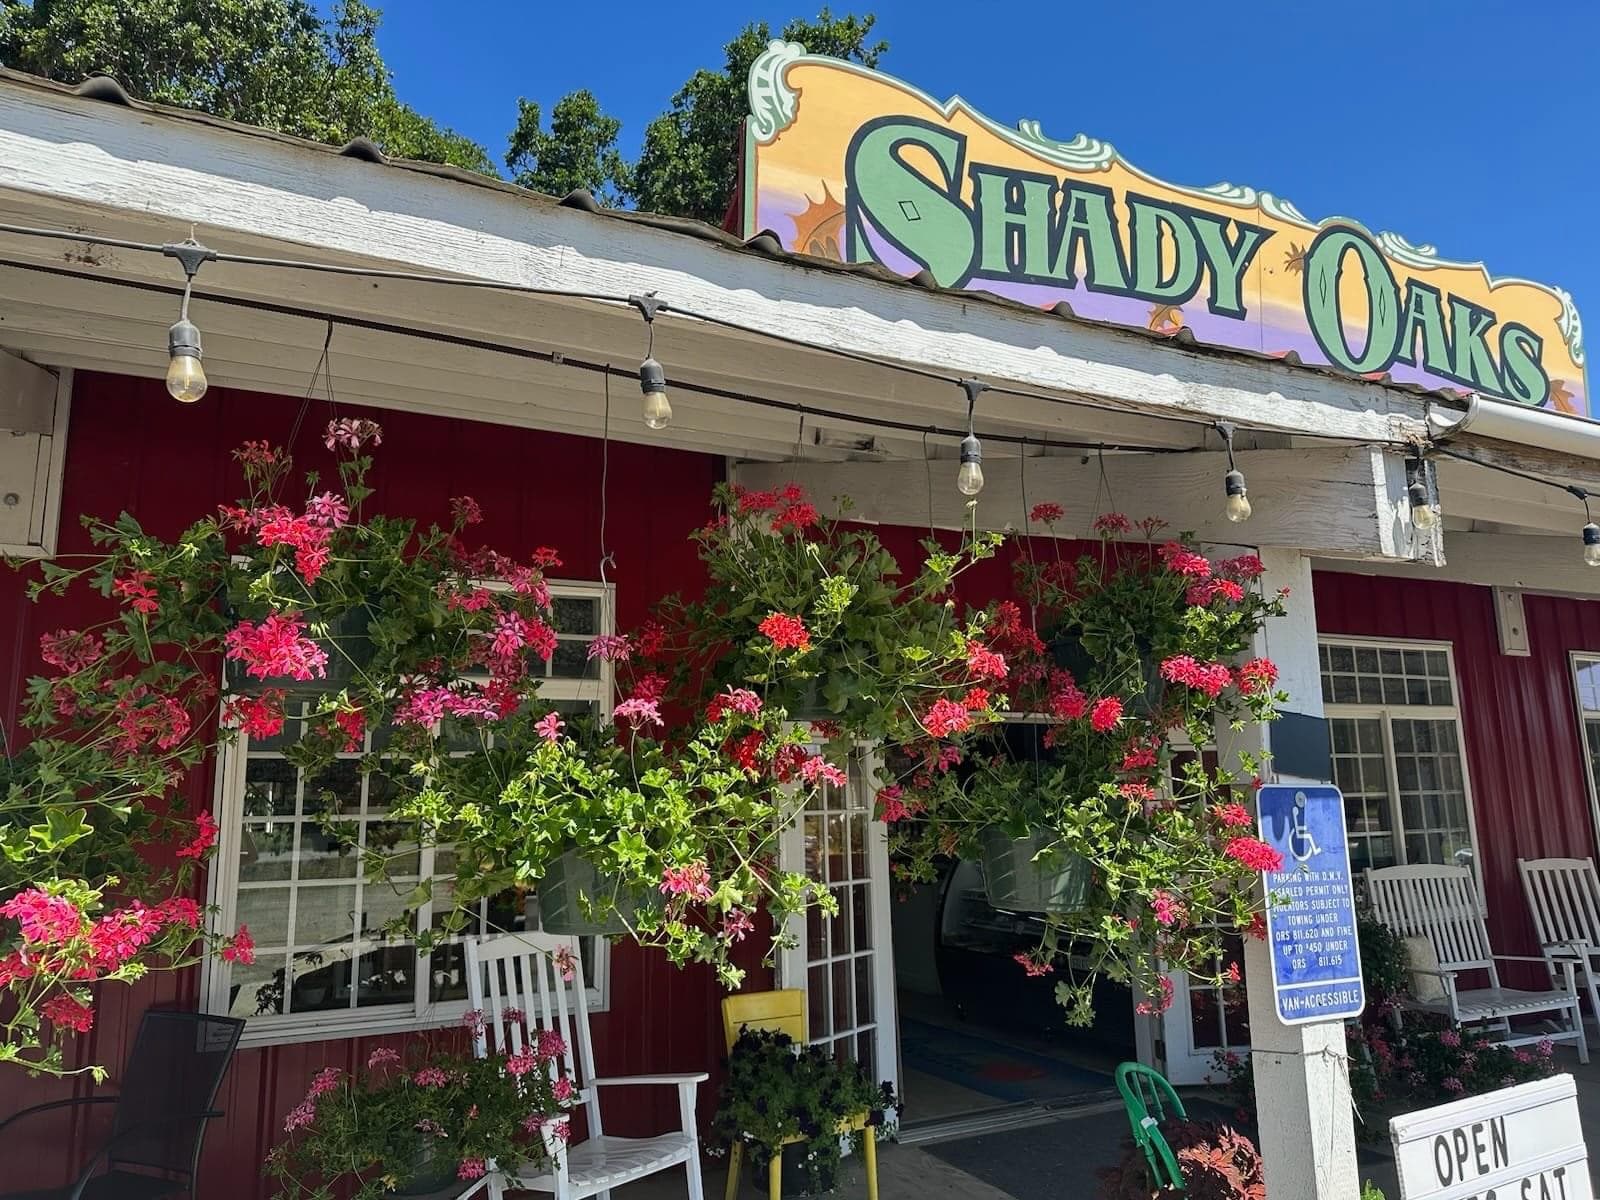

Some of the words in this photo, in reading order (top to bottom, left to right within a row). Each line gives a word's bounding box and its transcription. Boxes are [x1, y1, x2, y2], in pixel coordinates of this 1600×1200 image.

[845, 115, 1277, 320] SHADY
[1303, 225, 1550, 407] OAKS
[1273, 872, 1302, 883] PARKING
[1304, 871, 1320, 882] WITH
[1322, 871, 1344, 881] D.M.V.
[1306, 885, 1330, 896] PERMIT
[1332, 884, 1349, 895] ONLY
[1311, 898, 1340, 910] SUBJECT
[1342, 898, 1351, 909] TO
[1288, 914, 1313, 926] TOWING
[1315, 912, 1339, 924] UNDER
[1275, 930, 1290, 942] ORS
[1292, 928, 1319, 941] 811.620
[1321, 927, 1334, 938] AND
[1337, 925, 1353, 937] FINE
[1283, 945, 1292, 956] UP
[1295, 944, 1303, 955] TO
[1305, 942, 1322, 953] $450
[1325, 940, 1348, 951] UNDER
[1292, 958, 1306, 969] ORS
[1318, 955, 1343, 967] 811.615
[1281, 989, 1360, 1011] VAN-ACCESSIBLE
[1434, 1115, 1509, 1187] OPEN
